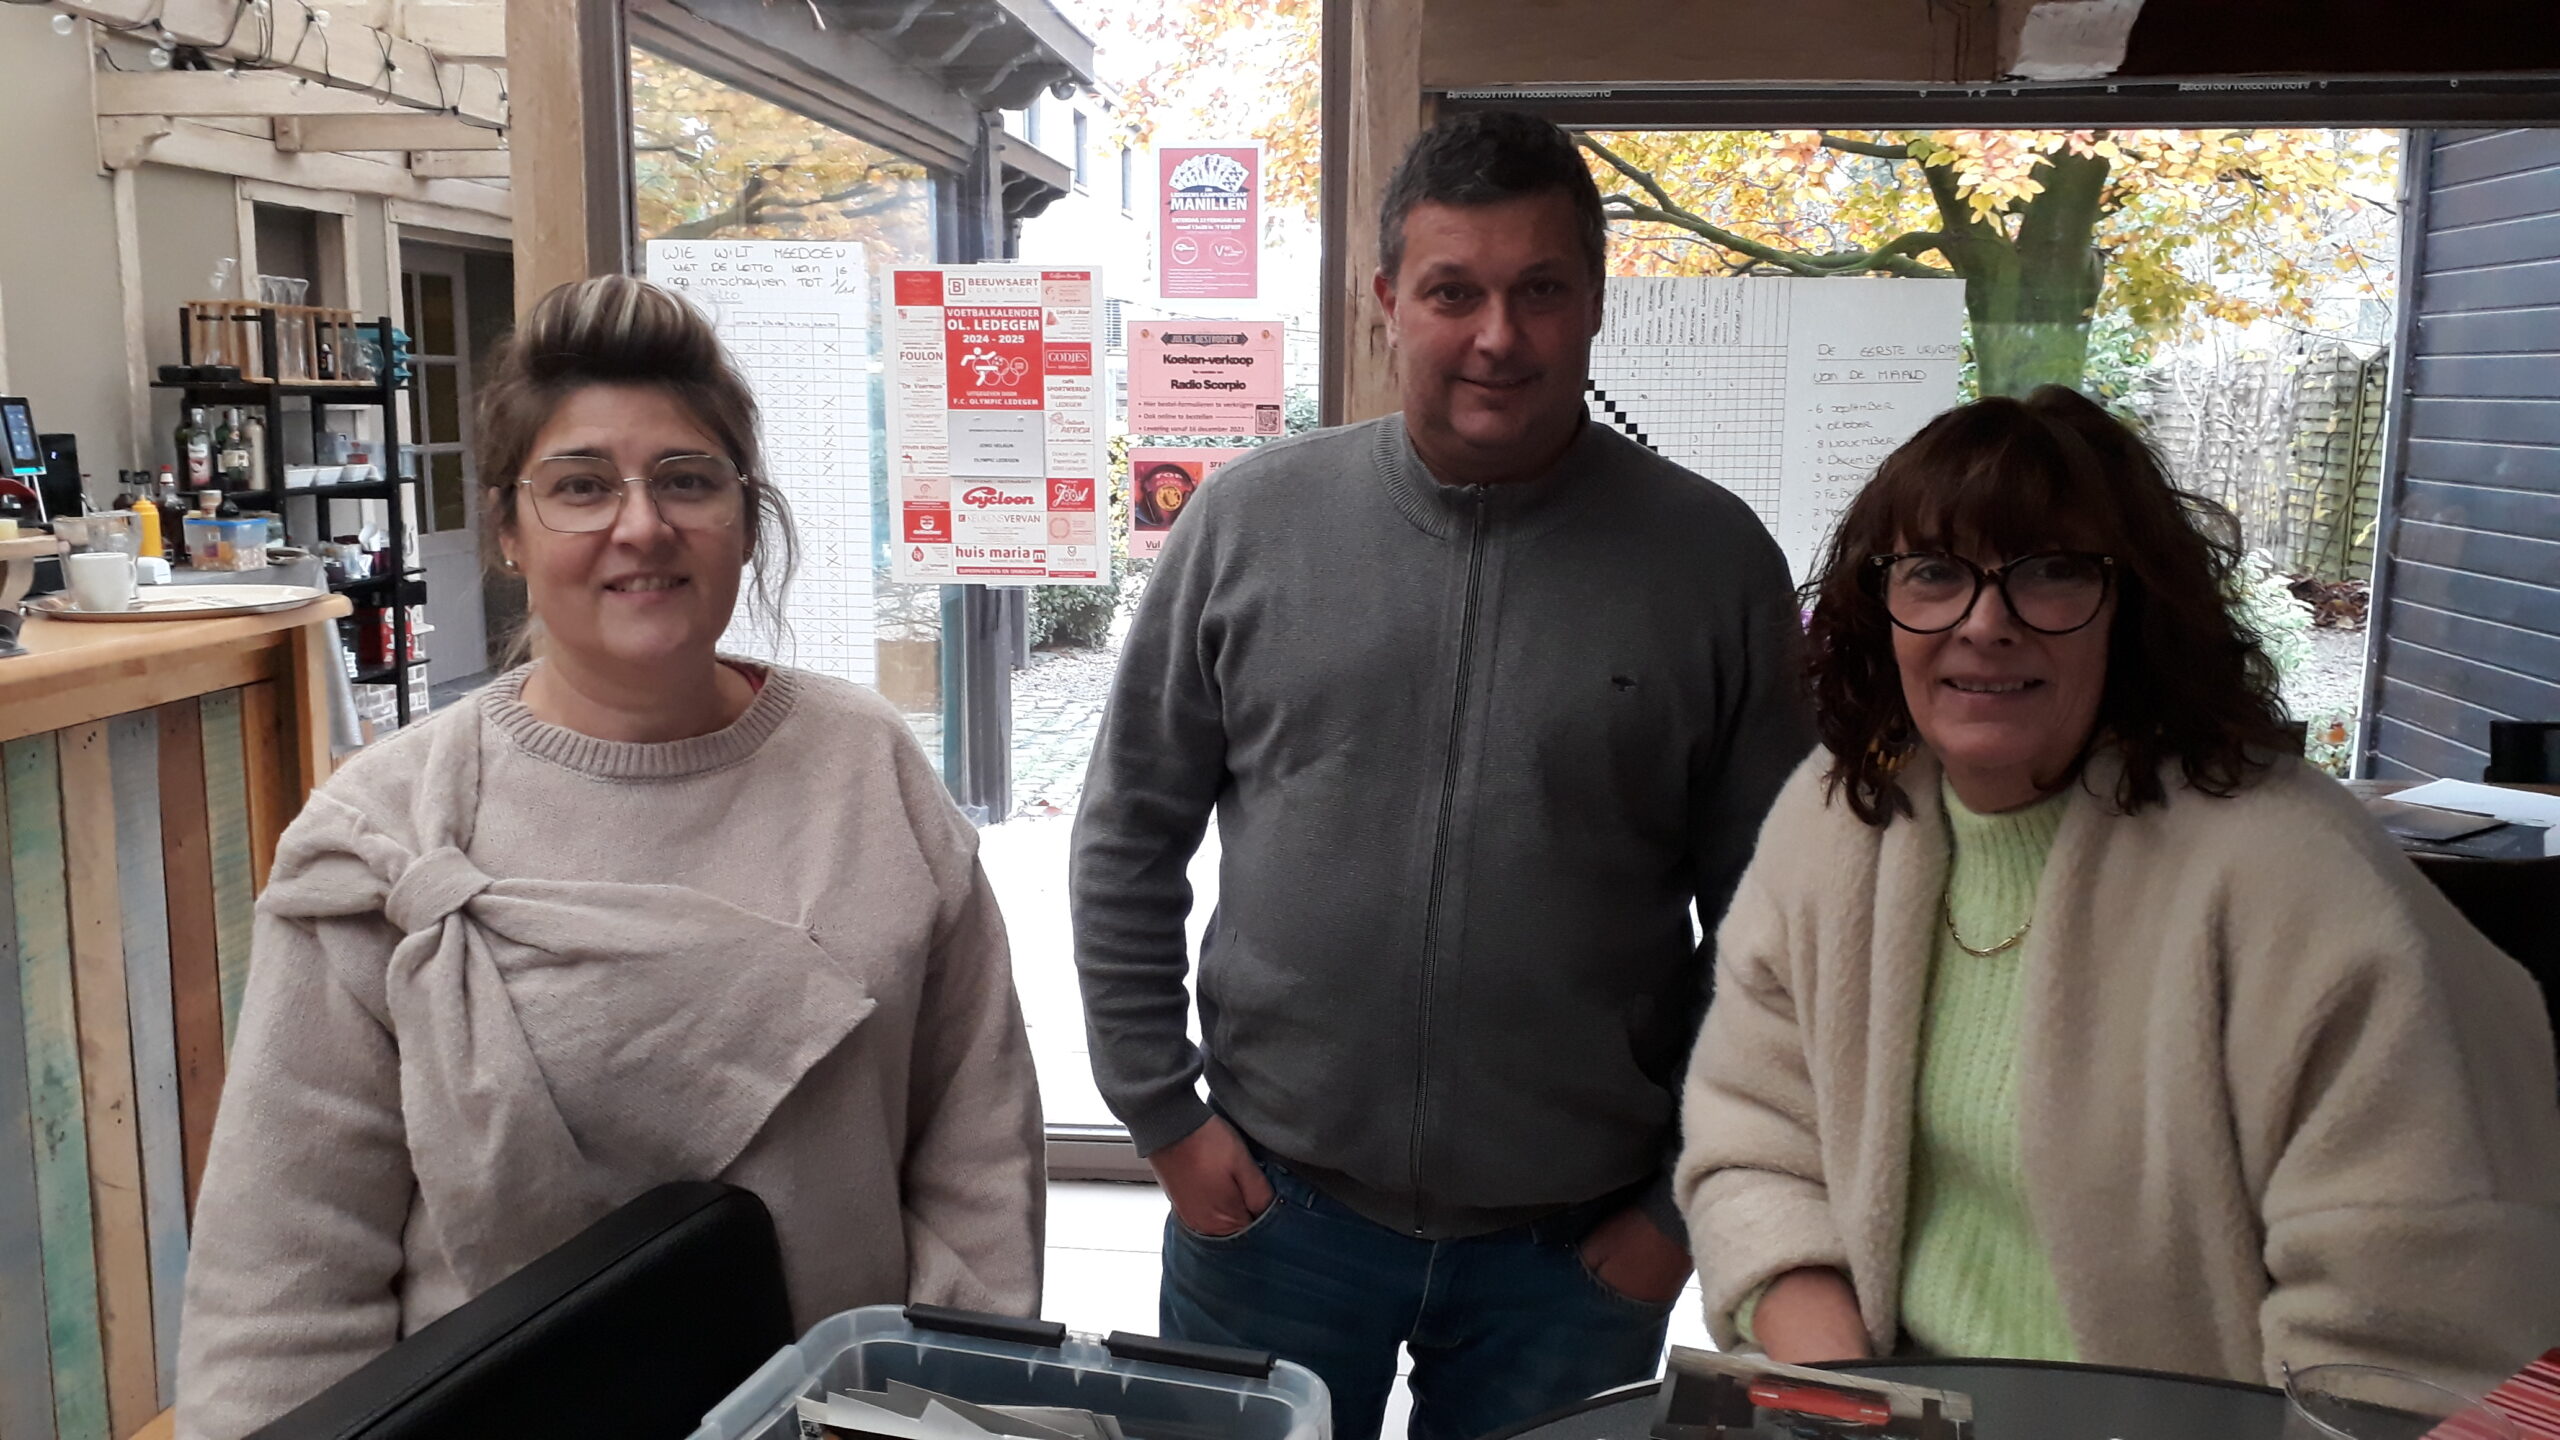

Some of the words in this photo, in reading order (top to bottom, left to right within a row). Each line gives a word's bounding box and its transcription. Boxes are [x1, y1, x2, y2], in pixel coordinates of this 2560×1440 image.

[1170, 198, 1248, 211] MANILLEN
[662, 247, 695, 260] WIE
[714, 246, 754, 259] WILT
[774, 247, 846, 260] MEEDOEN
[711, 263, 727, 272] DE
[736, 264, 774, 273] LOTTO
[797, 277, 823, 287] TOT
[952, 281, 962, 292] B
[968, 278, 1039, 286] BEEUWSAERT
[946, 309, 1039, 317] VOETBALKALENDER
[947, 319, 971, 331] OL.
[974, 319, 1040, 331] LEDEGEM
[962, 334, 990, 344] 2024
[998, 335, 1025, 344] 2025
[900, 351, 943, 361] FOULON
[1860, 345, 1906, 357] EERSTE
[1163, 354, 1254, 367] Koeken-verkoop
[1171, 380, 1203, 390] Radio
[1203, 380, 1247, 392] Scorpio
[1145, 540, 1161, 549] Vul
[955, 545, 985, 558] huis
[989, 545, 1031, 559] maria
